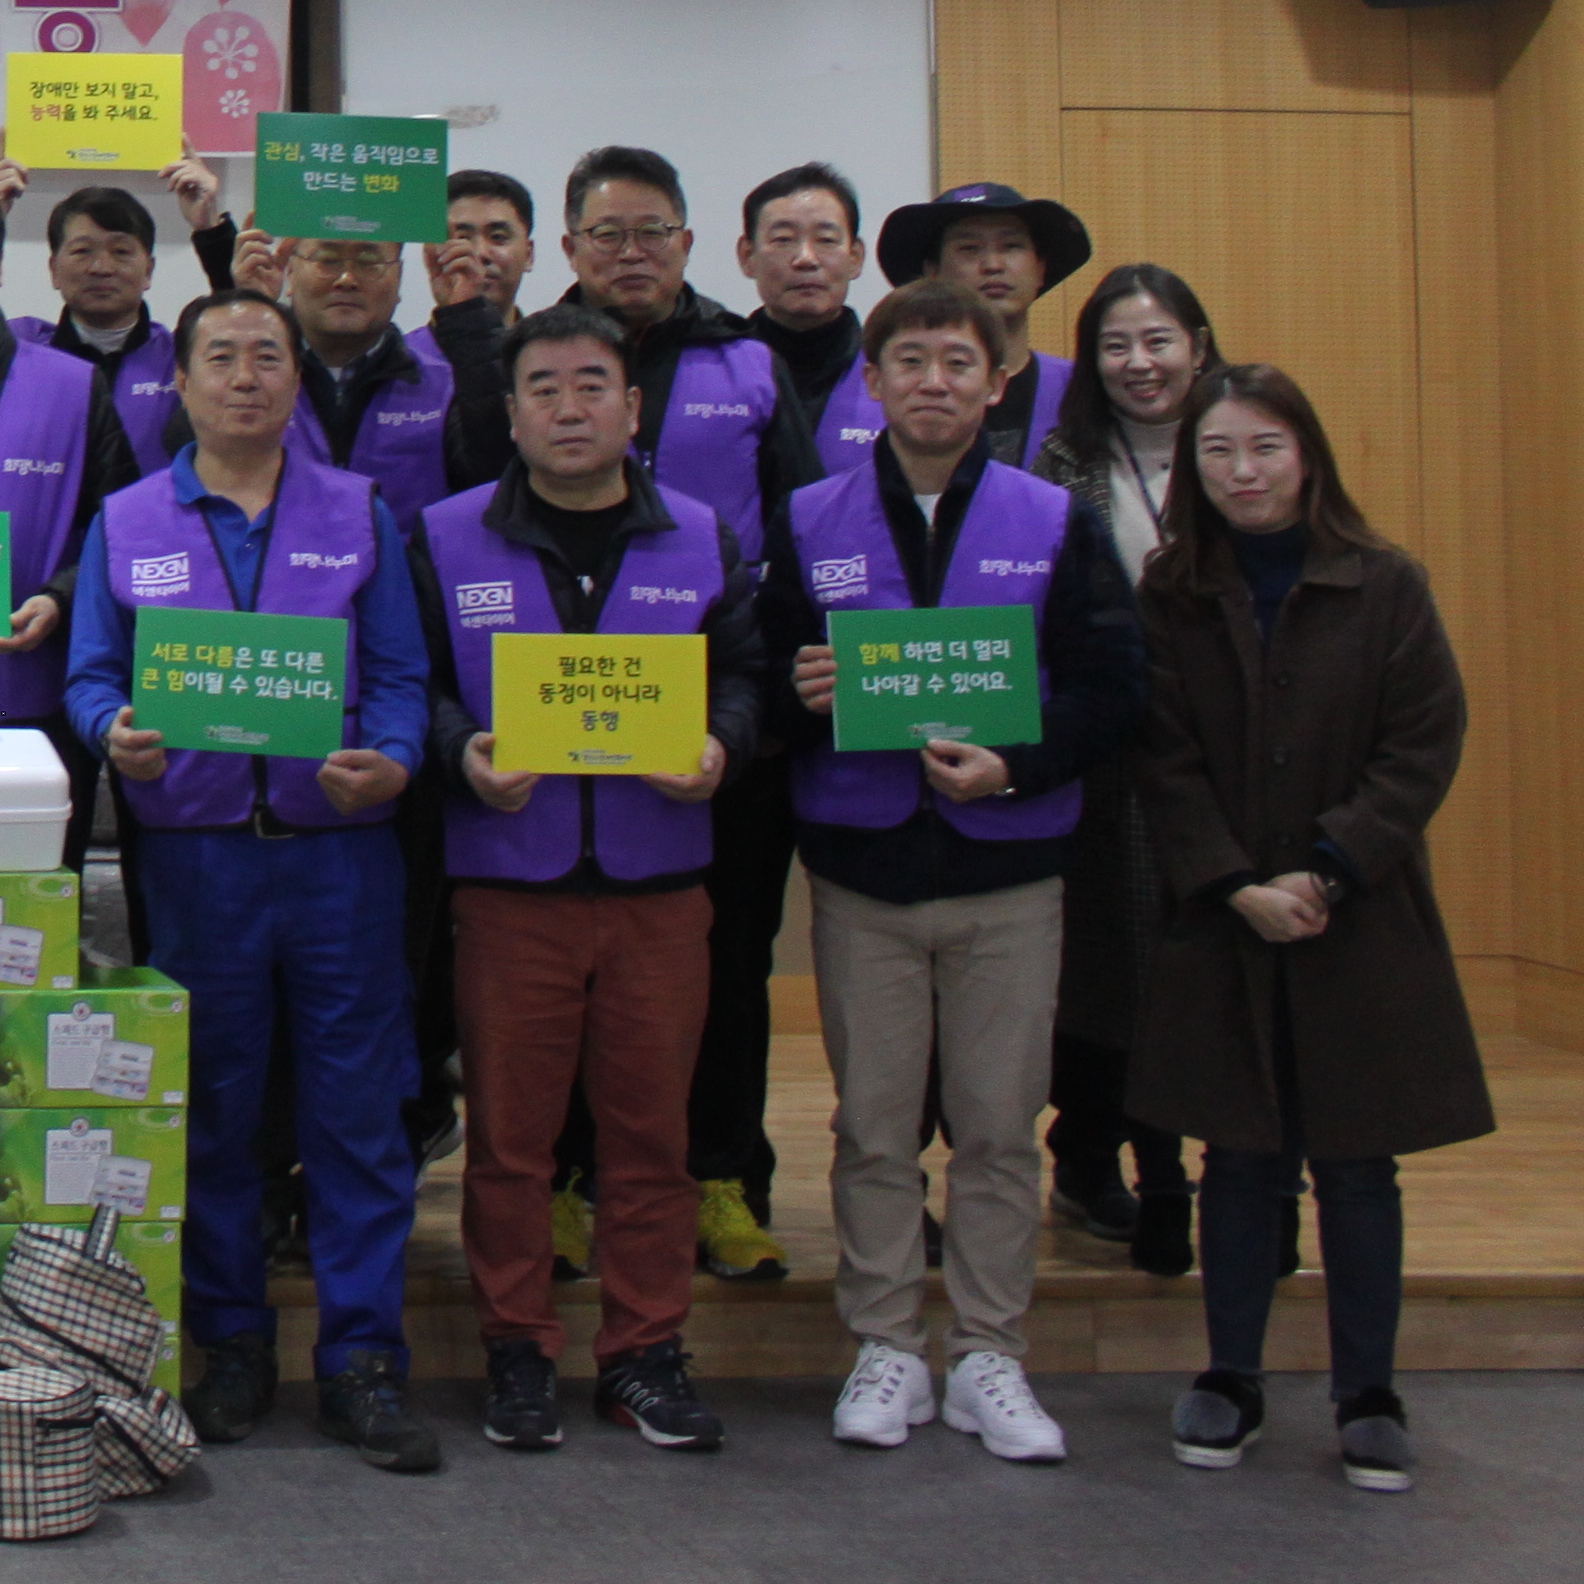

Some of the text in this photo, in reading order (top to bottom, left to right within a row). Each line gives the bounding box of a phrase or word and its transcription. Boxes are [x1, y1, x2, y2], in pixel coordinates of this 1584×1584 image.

[30, 82, 159, 100] 장애만 보지 말고,
[31, 105, 158, 122] 능력을 봐 주세요.
[311, 143, 346, 163] 작은
[352, 144, 439, 166] 움직임으로
[303, 172, 400, 193] 만드는 변화
[152, 642, 324, 674] 서로 다름은 또 다른
[859, 640, 1010, 665] 함께 하면 더 멀리
[559, 656, 641, 677] 필요한 건
[141, 668, 338, 700] 큰 수 있습니다.
[539, 683, 661, 704] 동정이 아니라
[862, 671, 1013, 696] 나아갈 수 있어요.
[581, 711, 619, 731] 동행
